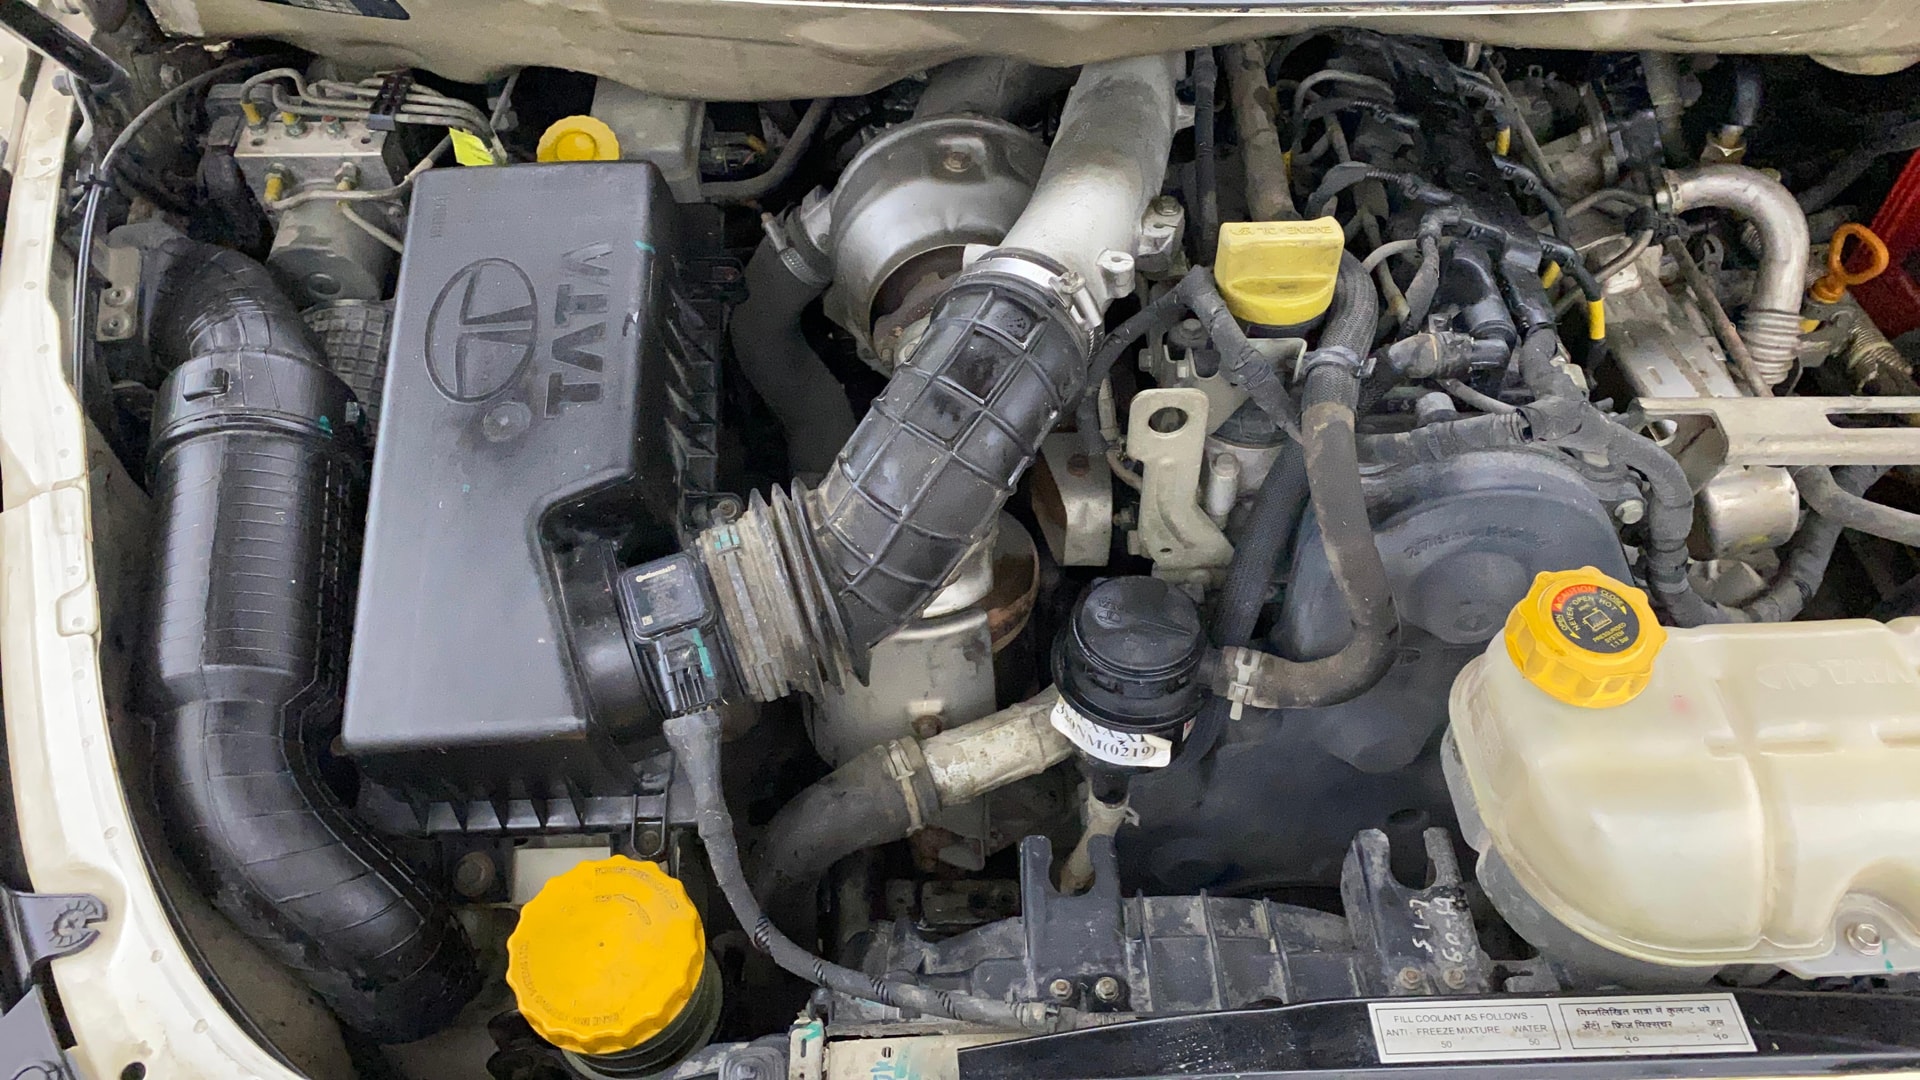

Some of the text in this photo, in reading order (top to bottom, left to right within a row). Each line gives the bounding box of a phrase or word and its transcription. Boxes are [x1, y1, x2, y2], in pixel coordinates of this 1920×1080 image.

[544, 241, 613, 420] TATA
[1557, 586, 1595, 602] CAUTION
[1573, 595, 1594, 605] OPEN
[1599, 598, 1618, 611] HOT
[1567, 607, 1580, 631] NEVER
[1393, 1015, 1414, 1023] FILL
[1415, 1013, 1463, 1023] COOLANT
[1464, 1013, 1478, 1022] AS
[1479, 1011, 1528, 1021] FOLLOWS
[1576, 1007, 1630, 1017] निम्नलिखित
[1632, 1006, 1652, 1015] मात्रा
[1386, 1028, 1408, 1037] ANTI
[1416, 1027, 1455, 1036] FREEZE
[1456, 1025, 1500, 1035] MIXTURE
[1511, 1024, 1548, 1033] WATER
[1440, 1038, 1540, 1049] 50 50
